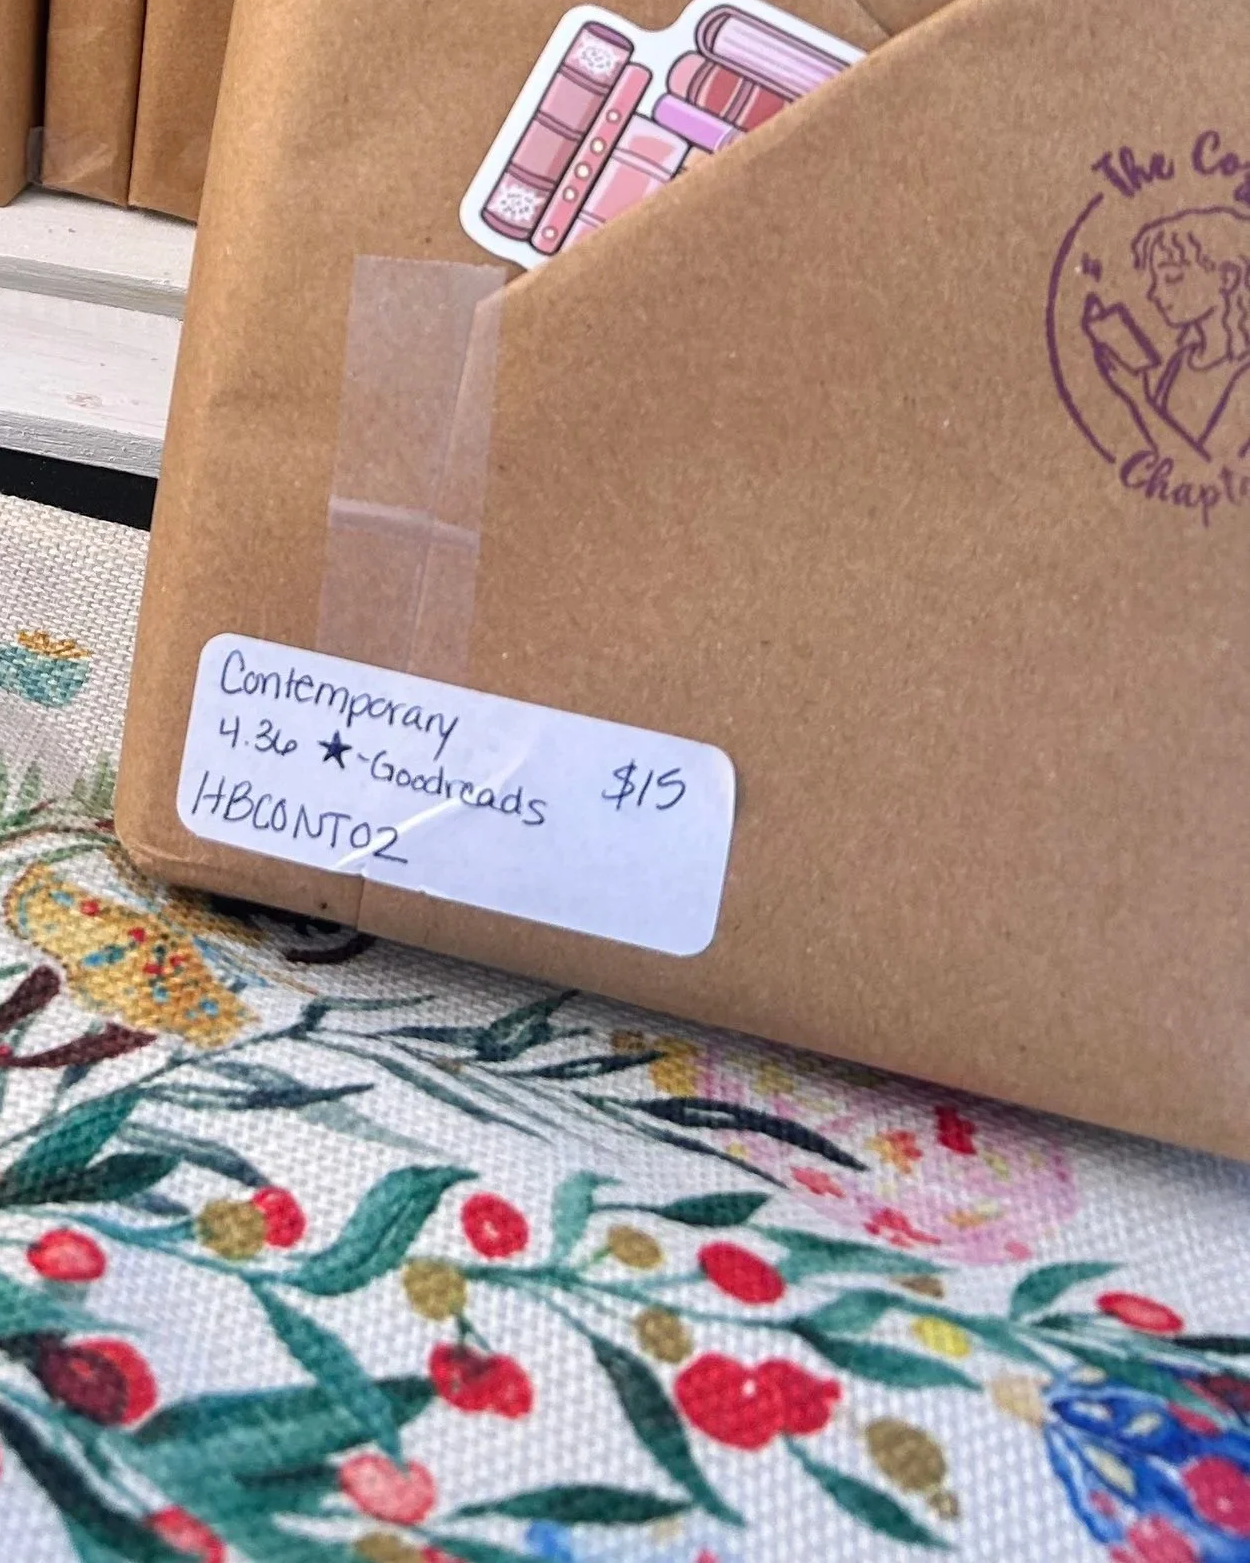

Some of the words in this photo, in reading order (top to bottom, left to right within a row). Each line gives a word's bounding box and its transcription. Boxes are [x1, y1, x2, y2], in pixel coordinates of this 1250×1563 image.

[1091, 146, 1175, 198] The
[1192, 129, 1250, 177] Co
[219, 649, 460, 760] Contemporary
[218, 715, 299, 758] 4.36
[601, 759, 687, 812] $15
